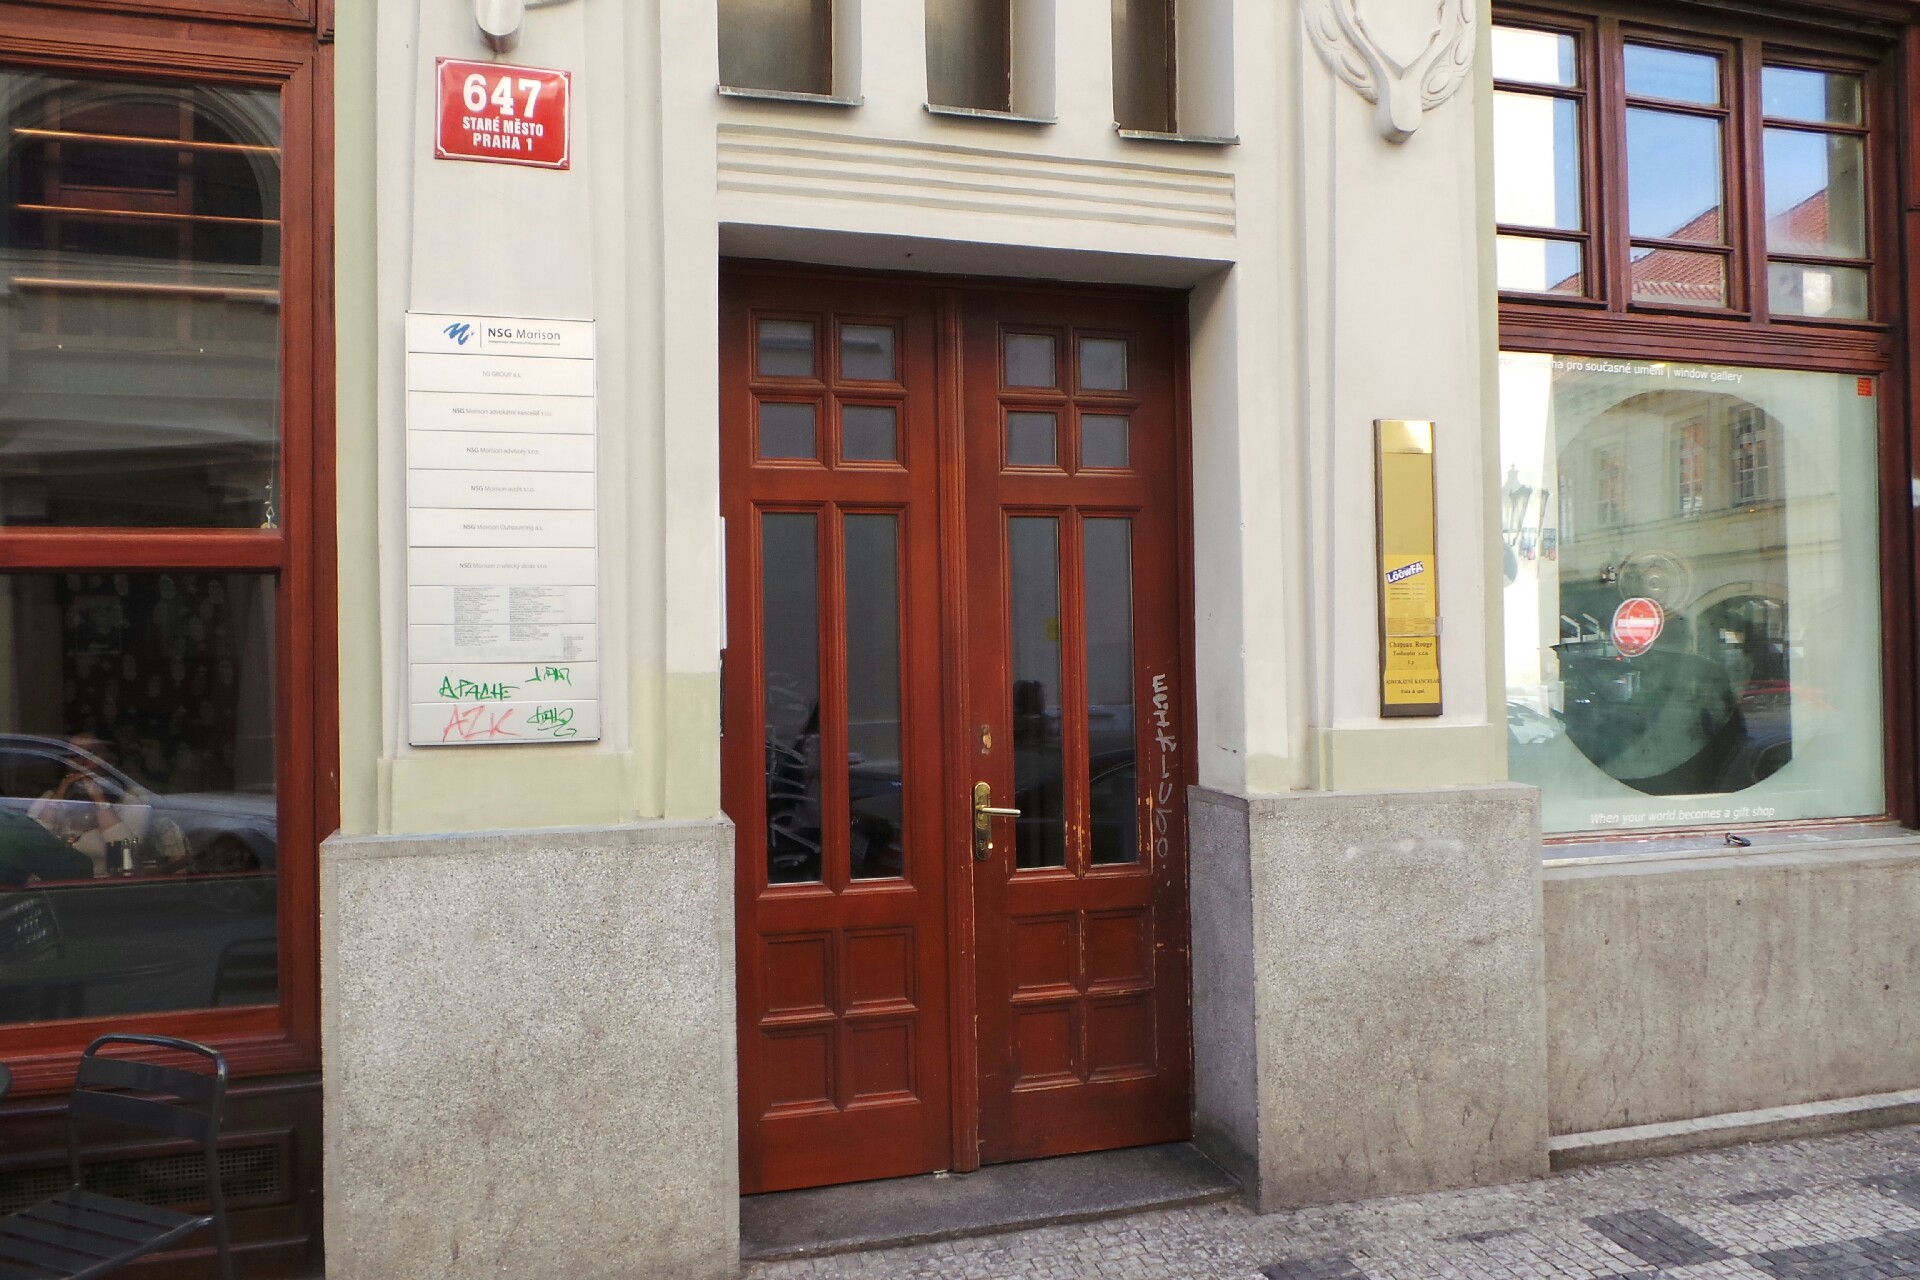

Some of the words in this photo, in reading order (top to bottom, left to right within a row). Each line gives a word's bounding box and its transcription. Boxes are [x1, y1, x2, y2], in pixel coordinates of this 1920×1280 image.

[463, 73, 542, 118] 647
[462, 116, 500, 132] STARÉ
[503, 118, 544, 137] MĚSTO
[472, 132, 520, 151] PRAHA
[525, 137, 533, 151] 1
[488, 327, 512, 338] NSG
[516, 329, 561, 341] Morison
[1567, 362, 1583, 371] pro
[1586, 362, 1631, 374] současné
[1673, 368, 1708, 379] window
[1710, 371, 1743, 384] gallery
[480, 447, 503, 455] Morison
[1590, 813, 1619, 824] When
[1622, 814, 1644, 824] your
[1648, 810, 1675, 821] world
[1679, 808, 1721, 820] becomes
[1724, 808, 1730, 818] a
[1733, 806, 1749, 820] gift
[1752, 805, 1775, 817] shop
